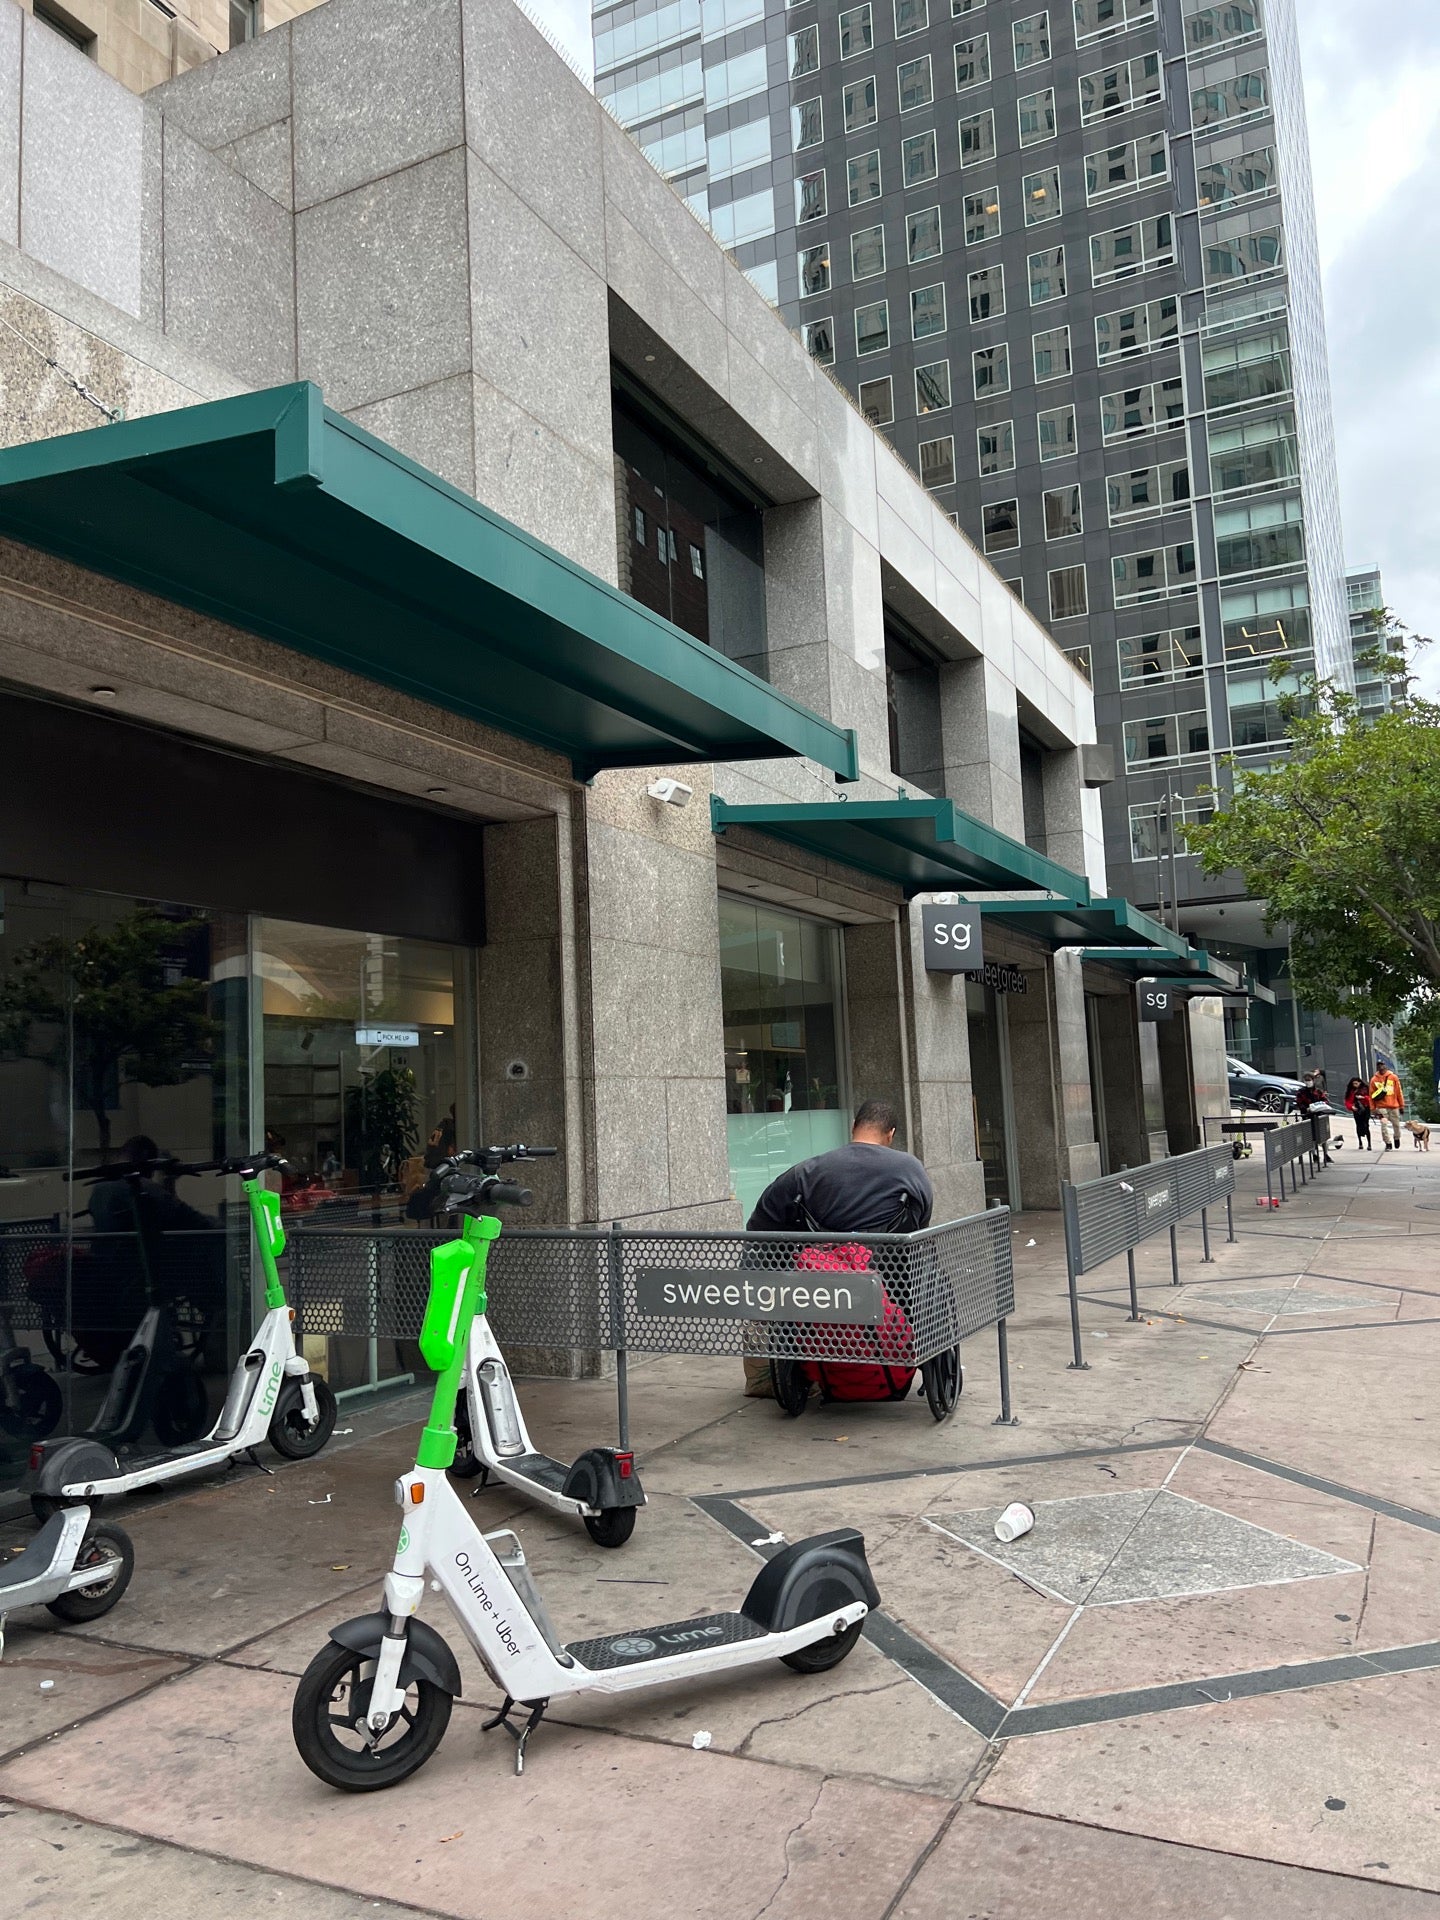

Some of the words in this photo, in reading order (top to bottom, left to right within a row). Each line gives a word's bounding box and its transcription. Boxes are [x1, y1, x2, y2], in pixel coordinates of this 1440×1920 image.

[933, 922, 972, 951] sg
[1146, 992, 1168, 1010] sg
[662, 1280, 853, 1312] sweetgreen
[257, 1361, 282, 1416] Lime
[455, 1552, 472, 1577] On
[467, 1574, 493, 1612] Lime
[491, 1611, 500, 1620] +
[495, 1619, 521, 1656] Uber
[659, 1626, 725, 1644] Lime
